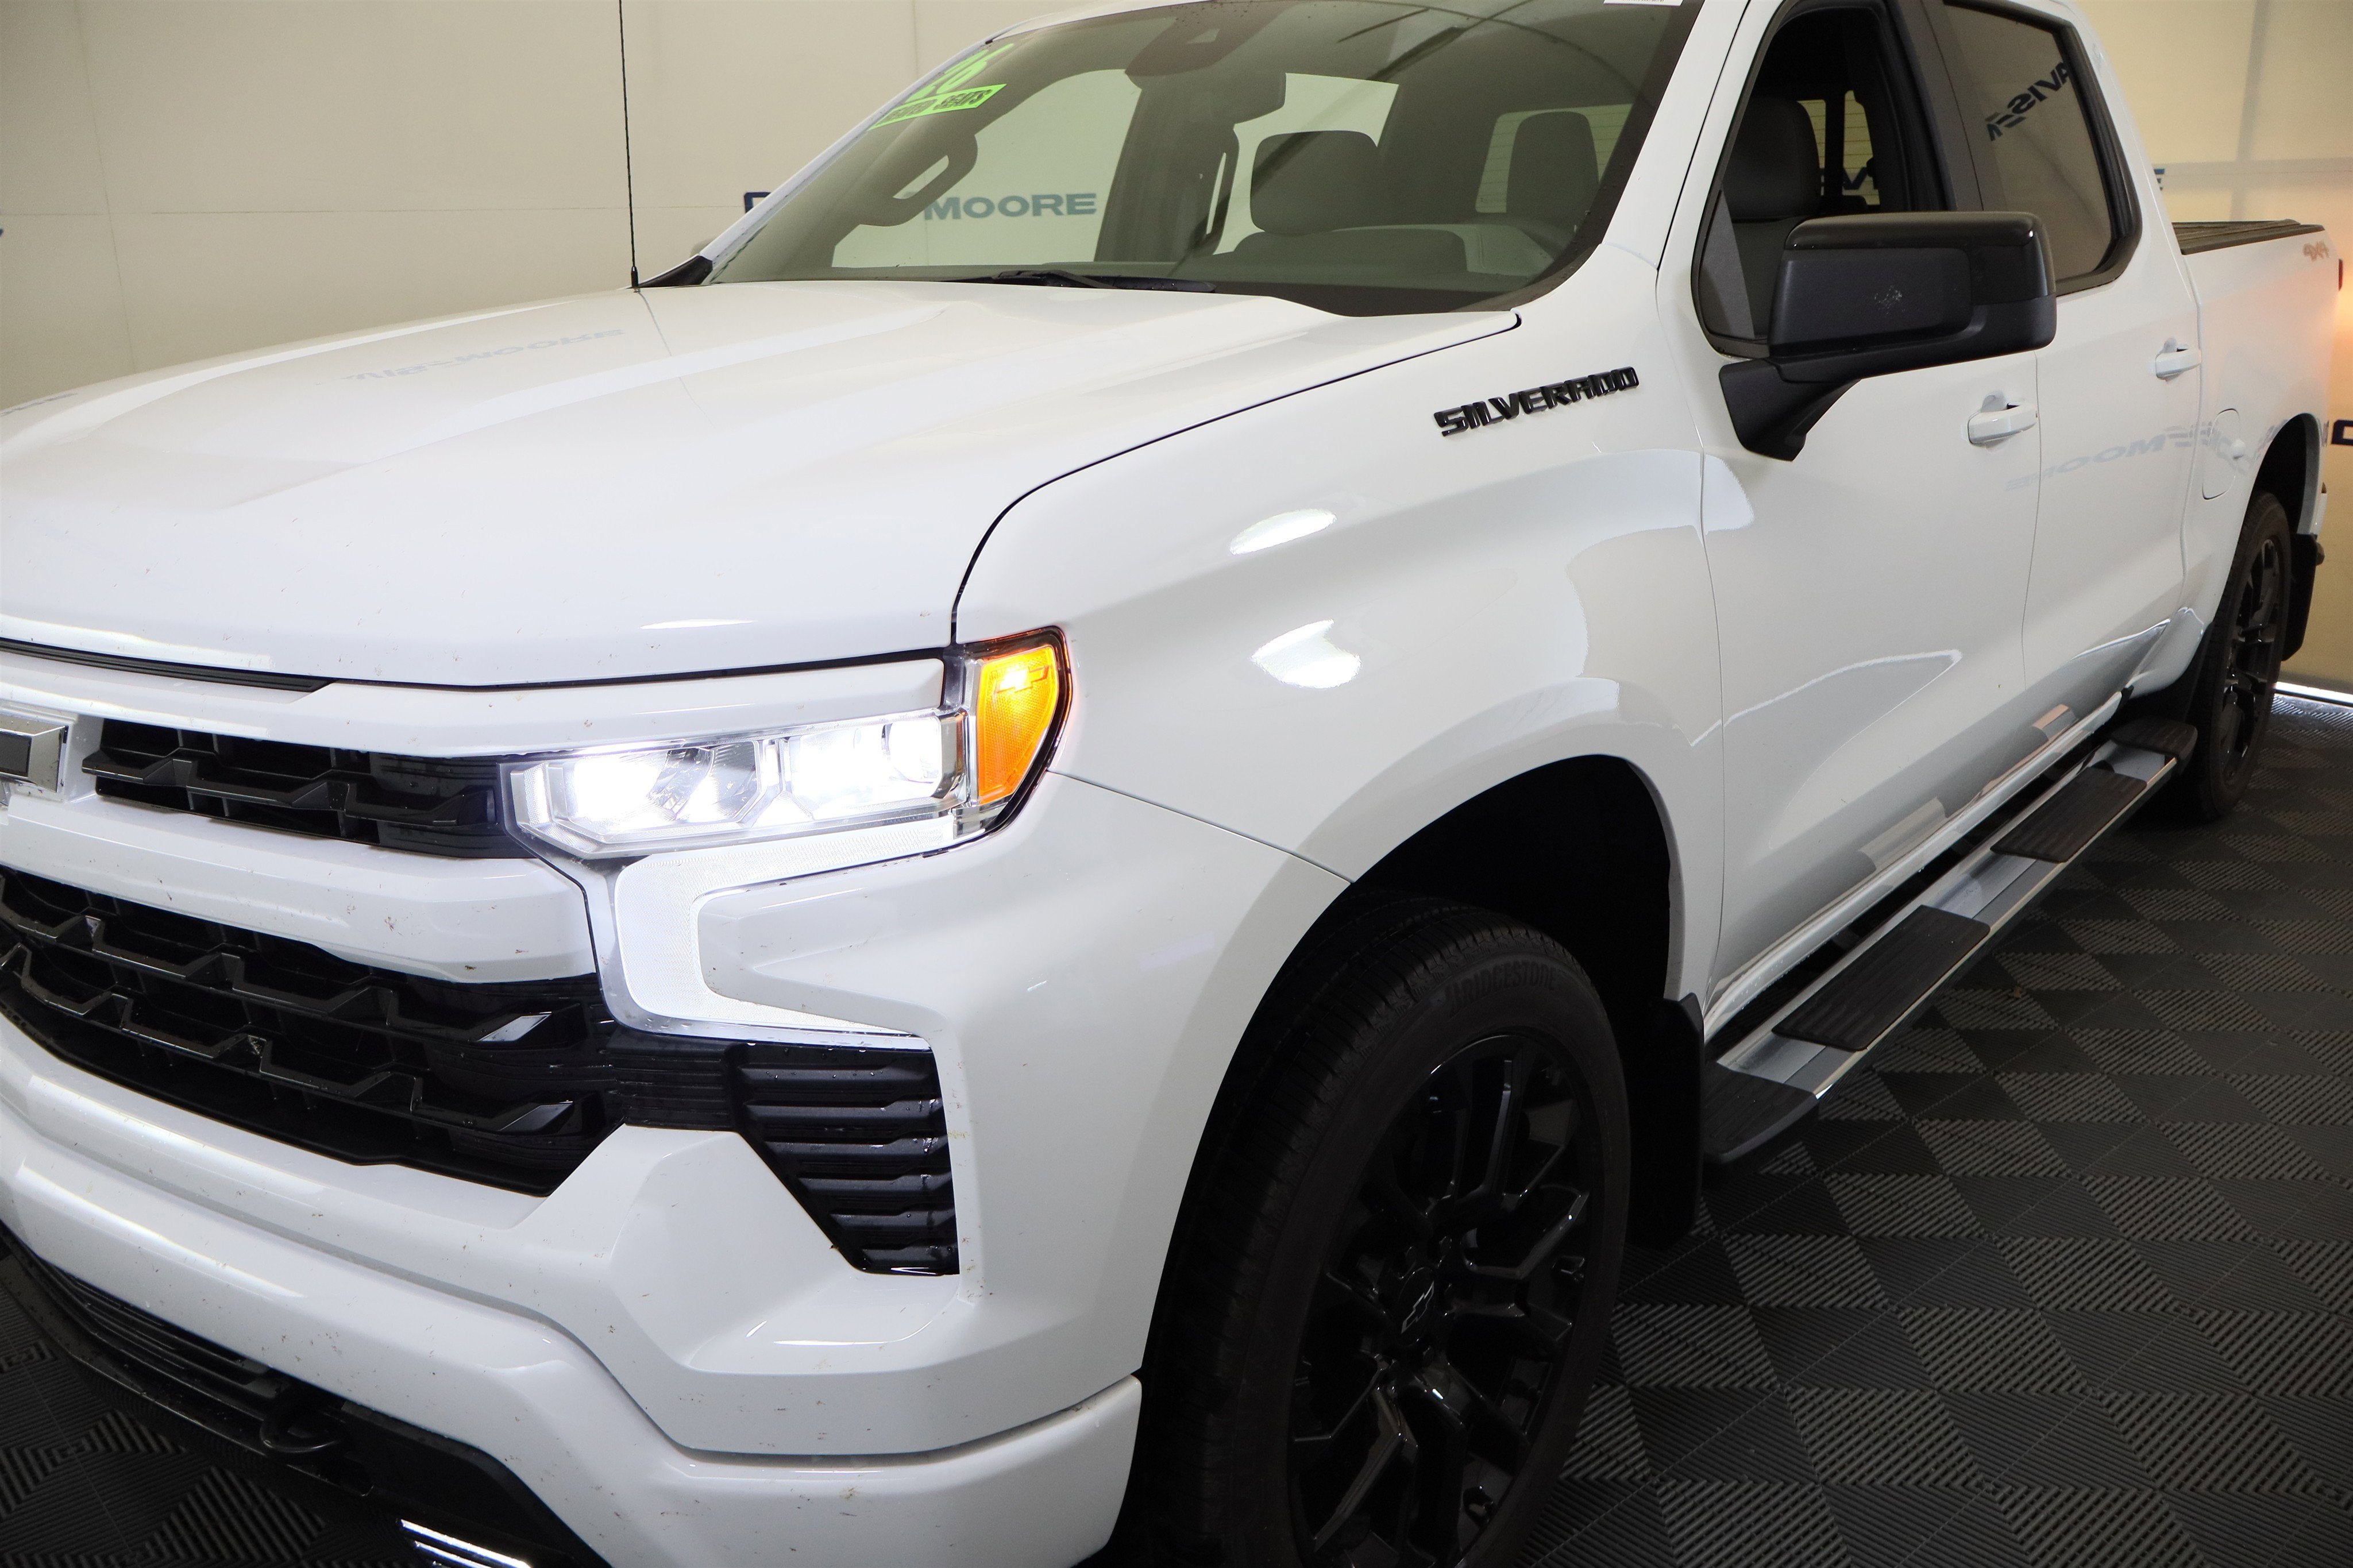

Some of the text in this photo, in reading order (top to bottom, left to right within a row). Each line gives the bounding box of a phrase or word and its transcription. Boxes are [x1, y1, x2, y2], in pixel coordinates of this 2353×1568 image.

[924, 193, 1097, 221] MOORE
[1433, 366, 1640, 437] SILVERADO
[1446, 960, 1554, 1018] BRIDGESTONE
